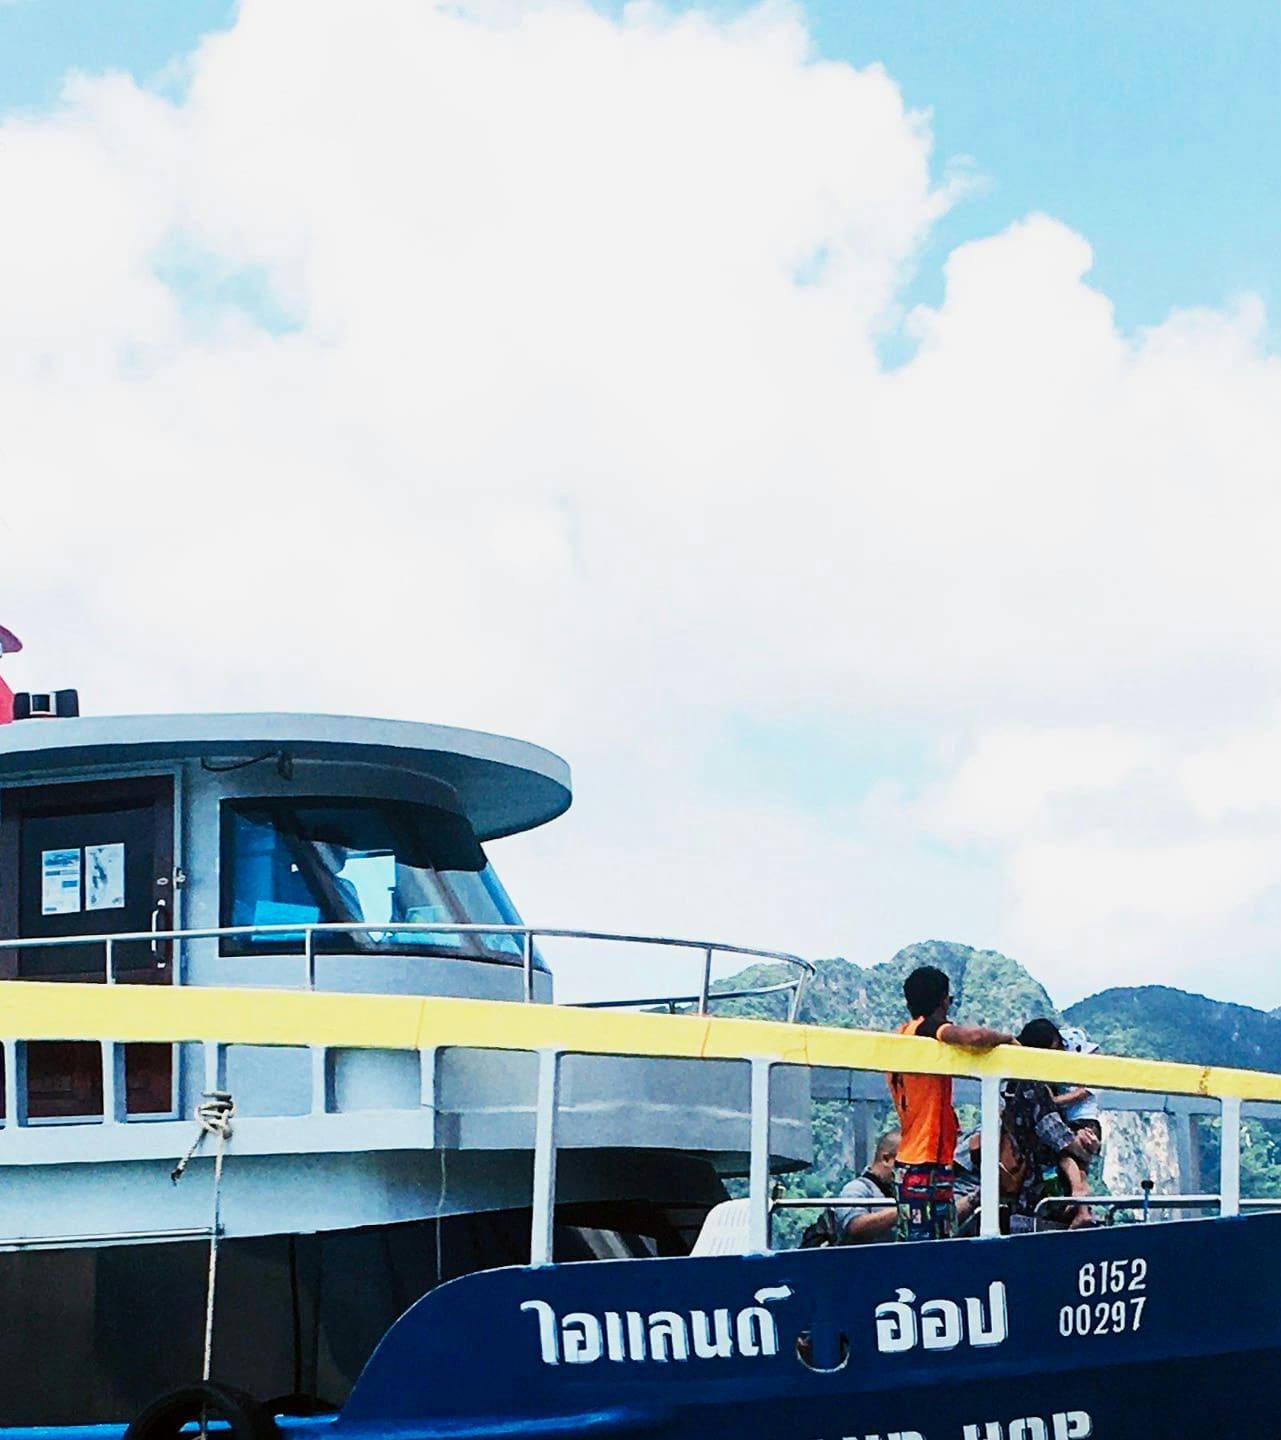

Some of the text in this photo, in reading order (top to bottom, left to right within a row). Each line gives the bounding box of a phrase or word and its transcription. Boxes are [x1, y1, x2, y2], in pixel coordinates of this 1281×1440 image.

[1077, 1257, 1148, 1298] 6152
[520, 1284, 793, 1366] ไอแลนด์
[1058, 1296, 1147, 1337] 00297
